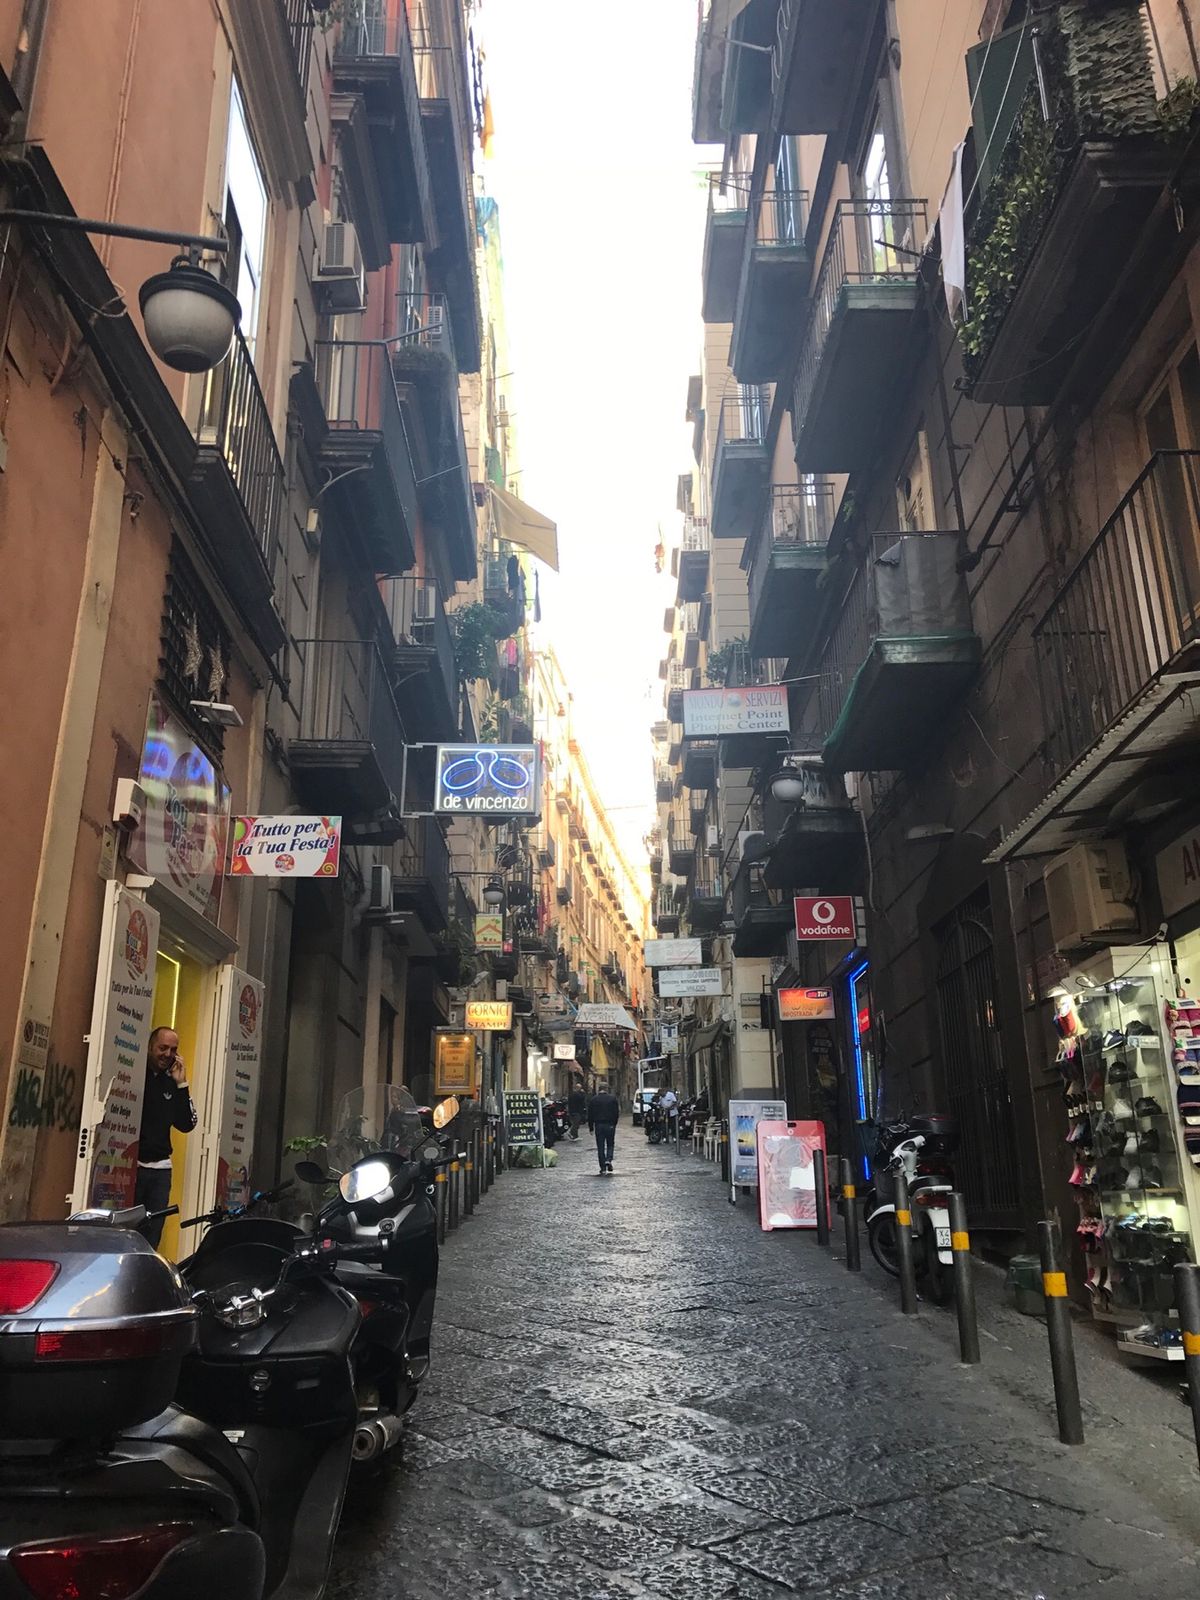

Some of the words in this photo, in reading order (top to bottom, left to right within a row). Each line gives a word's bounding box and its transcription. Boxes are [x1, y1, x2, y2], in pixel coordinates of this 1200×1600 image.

[746, 691, 783, 707] SERVIZI
[690, 712, 742, 722] Internet
[747, 709, 784, 720] Point
[691, 722, 733, 732] Phone
[737, 719, 784, 730] Center
[443, 793, 462, 809] de
[465, 793, 528, 810] vincenzo
[252, 823, 291, 838] Tutto
[293, 822, 321, 838] per
[237, 843, 253, 856] la
[257, 840, 286, 855] Tua
[289, 835, 336, 852] Festa!
[800, 924, 850, 935] vodafone
[468, 1003, 509, 1017] CORNICI
